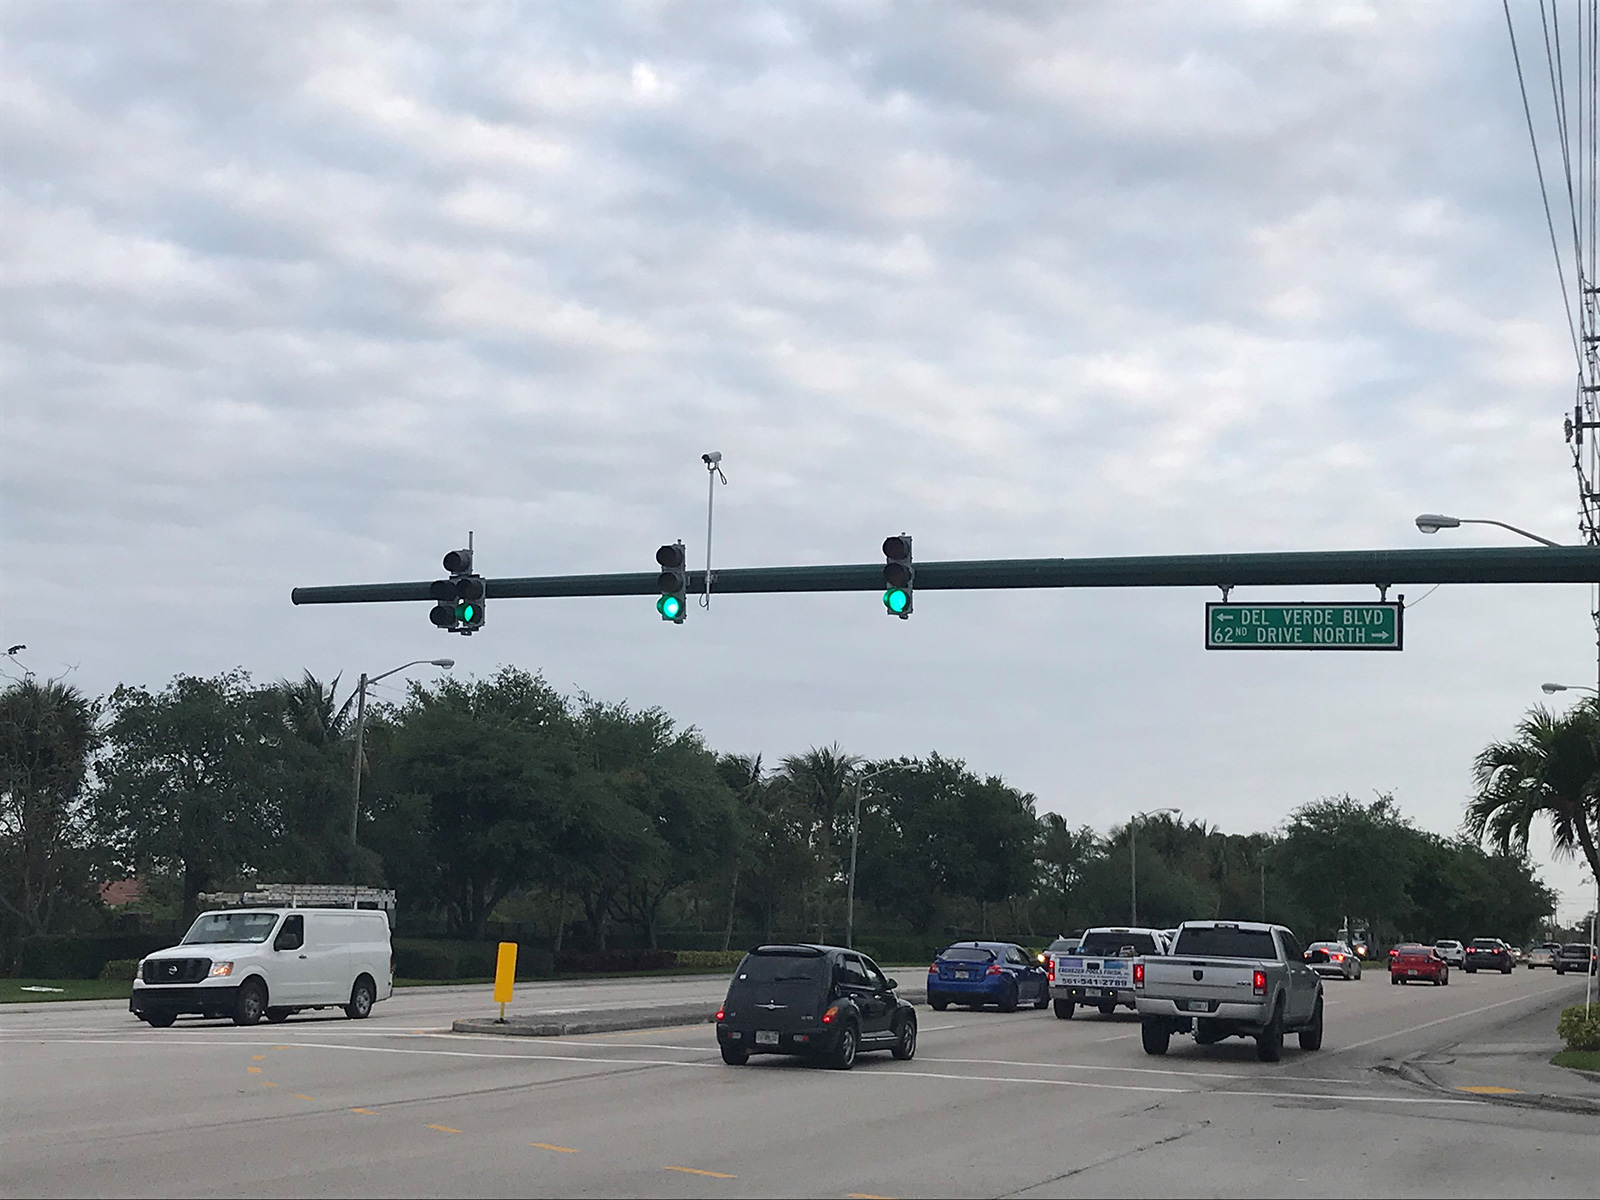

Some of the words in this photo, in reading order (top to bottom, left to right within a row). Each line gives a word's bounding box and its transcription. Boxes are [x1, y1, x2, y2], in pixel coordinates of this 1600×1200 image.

[1241, 609, 1270, 625] DEL
[1282, 609, 1334, 625] VERDE
[1343, 609, 1384, 625] BLVD
[1213, 626, 1248, 643] 62ND
[1257, 627, 1303, 643] DRIVE
[1313, 627, 1366, 643] NORTH
